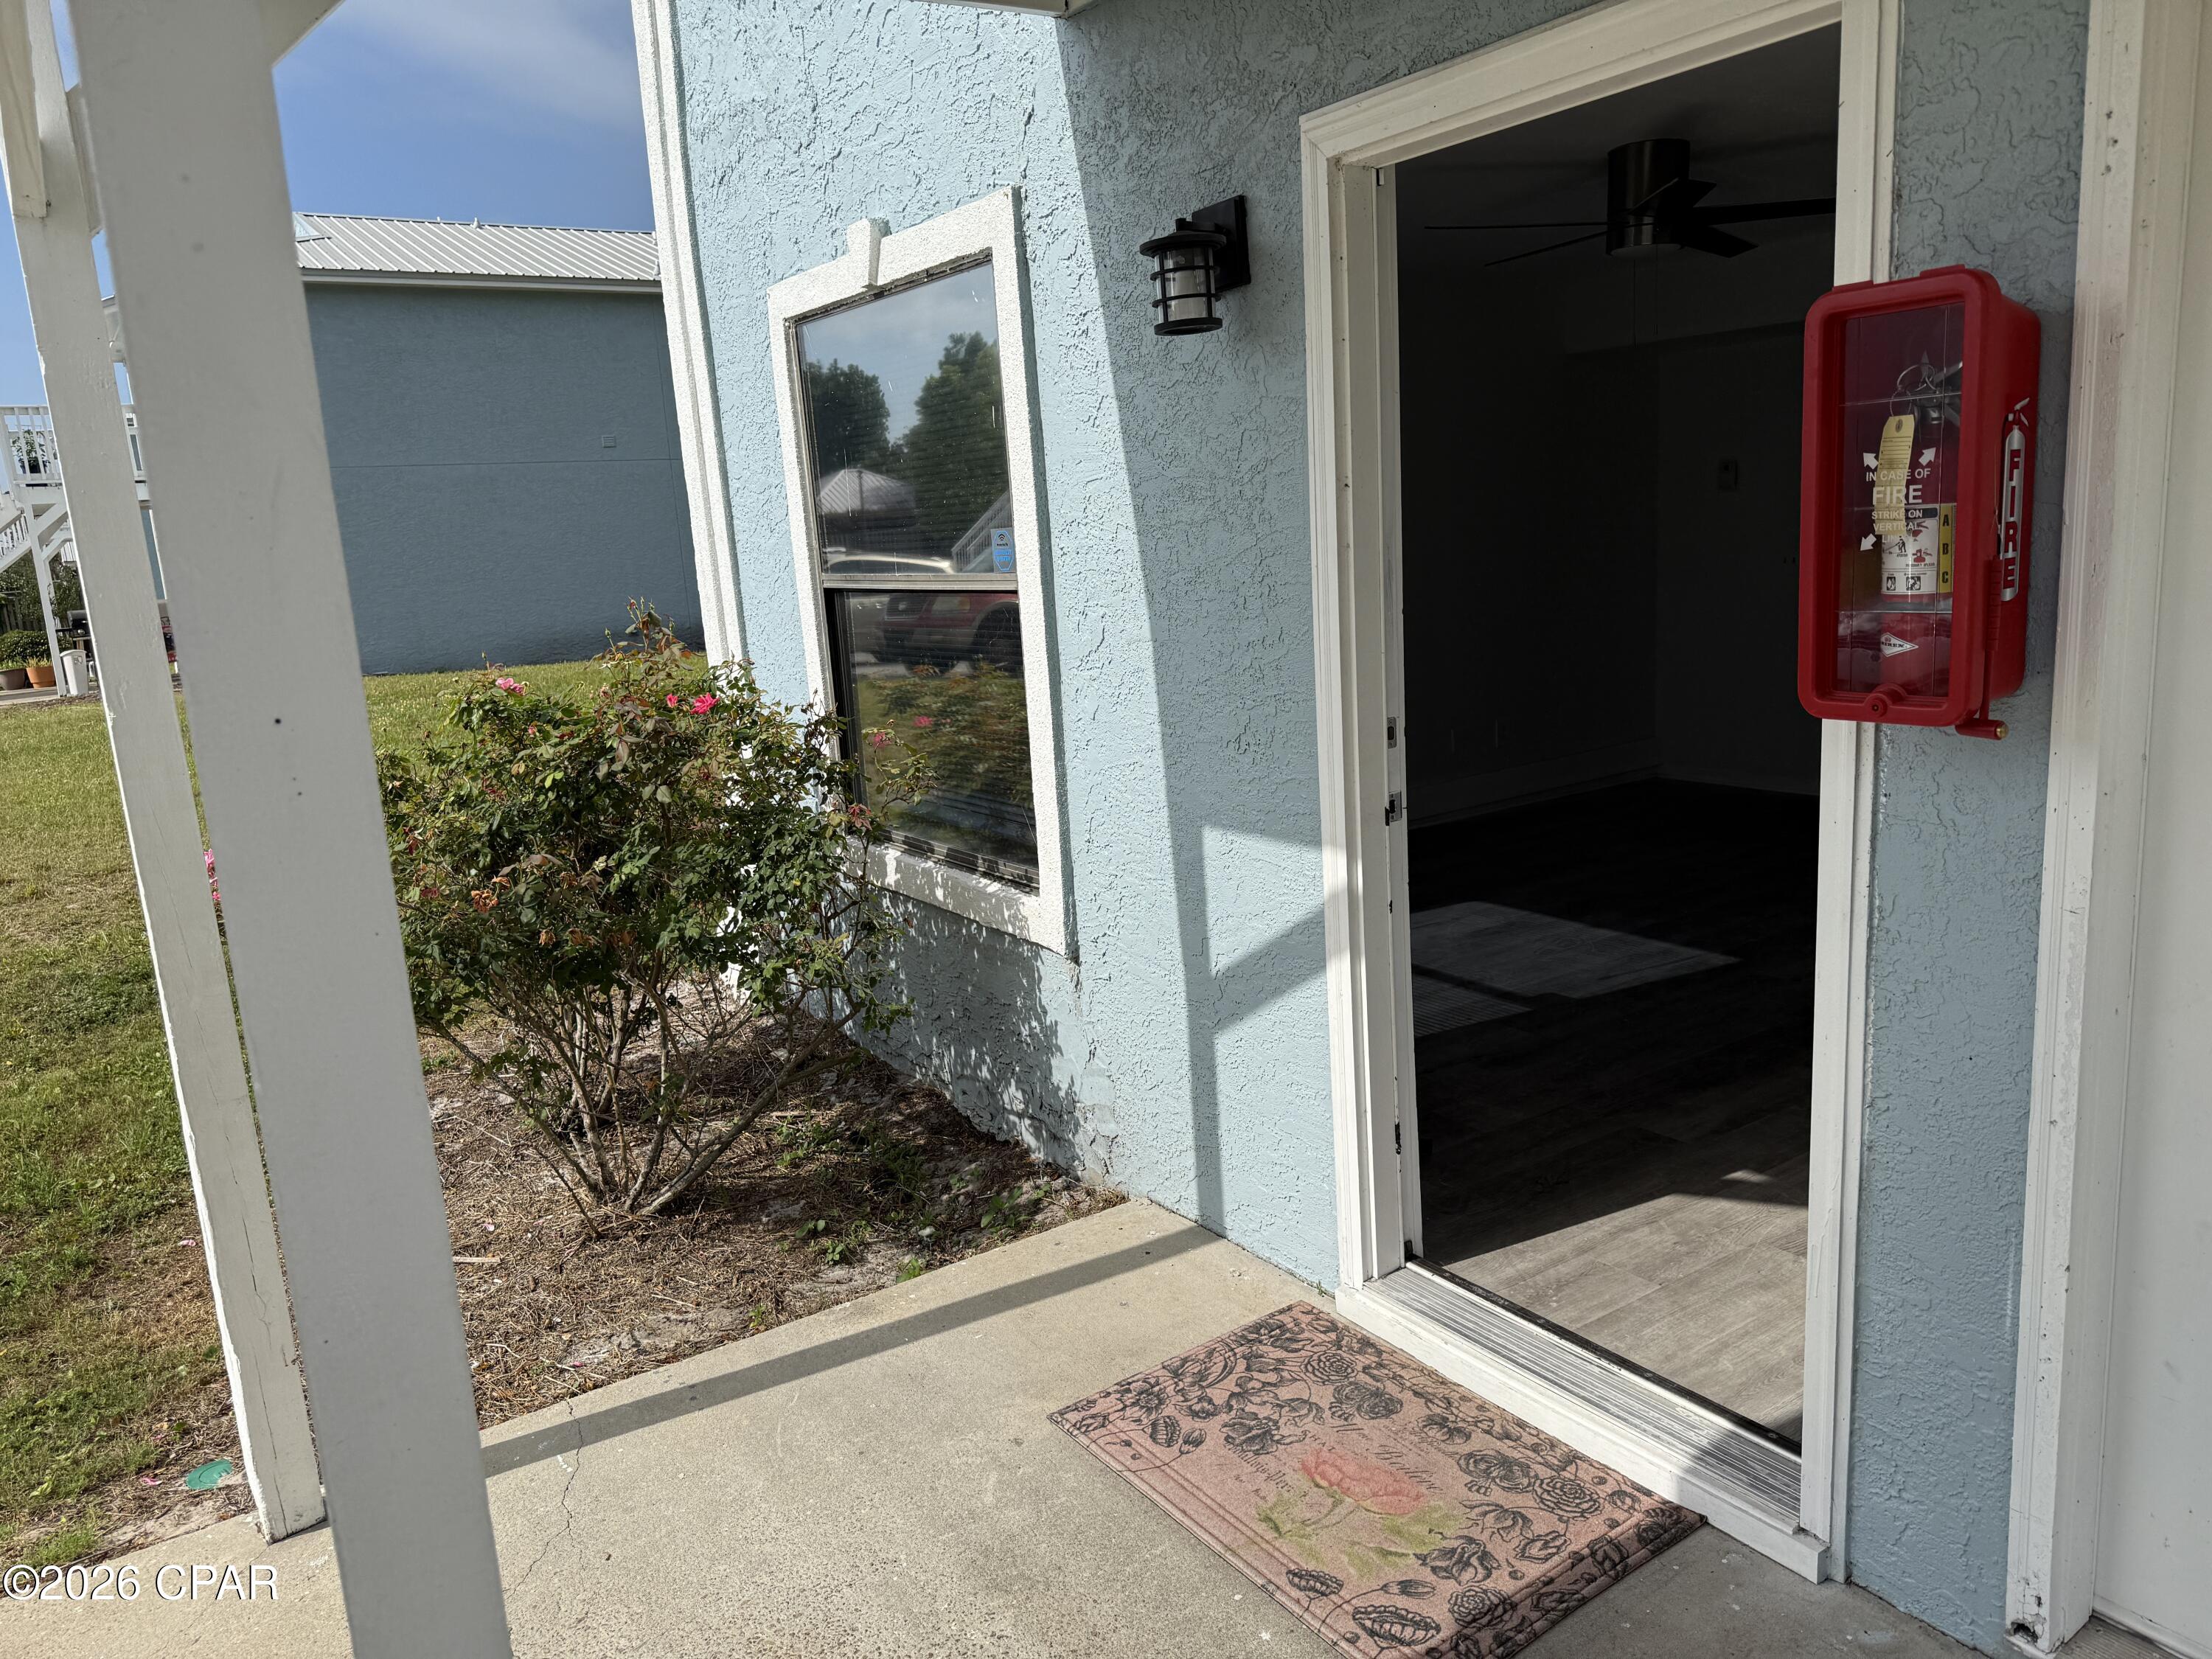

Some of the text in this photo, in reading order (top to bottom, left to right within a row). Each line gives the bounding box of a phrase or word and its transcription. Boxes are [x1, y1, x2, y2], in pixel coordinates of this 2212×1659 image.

[1865, 468, 1931, 481] IN CASE OF
[1873, 484, 1922, 505] FIRE
[1871, 509, 1923, 520] STRIKE ON
[1942, 514, 1950, 527] A
[2003, 449, 2021, 589] FIRE
[1873, 521, 1921, 532] VERTICAL
[1942, 543, 1950, 555] B
[1941, 571, 1950, 583] C
